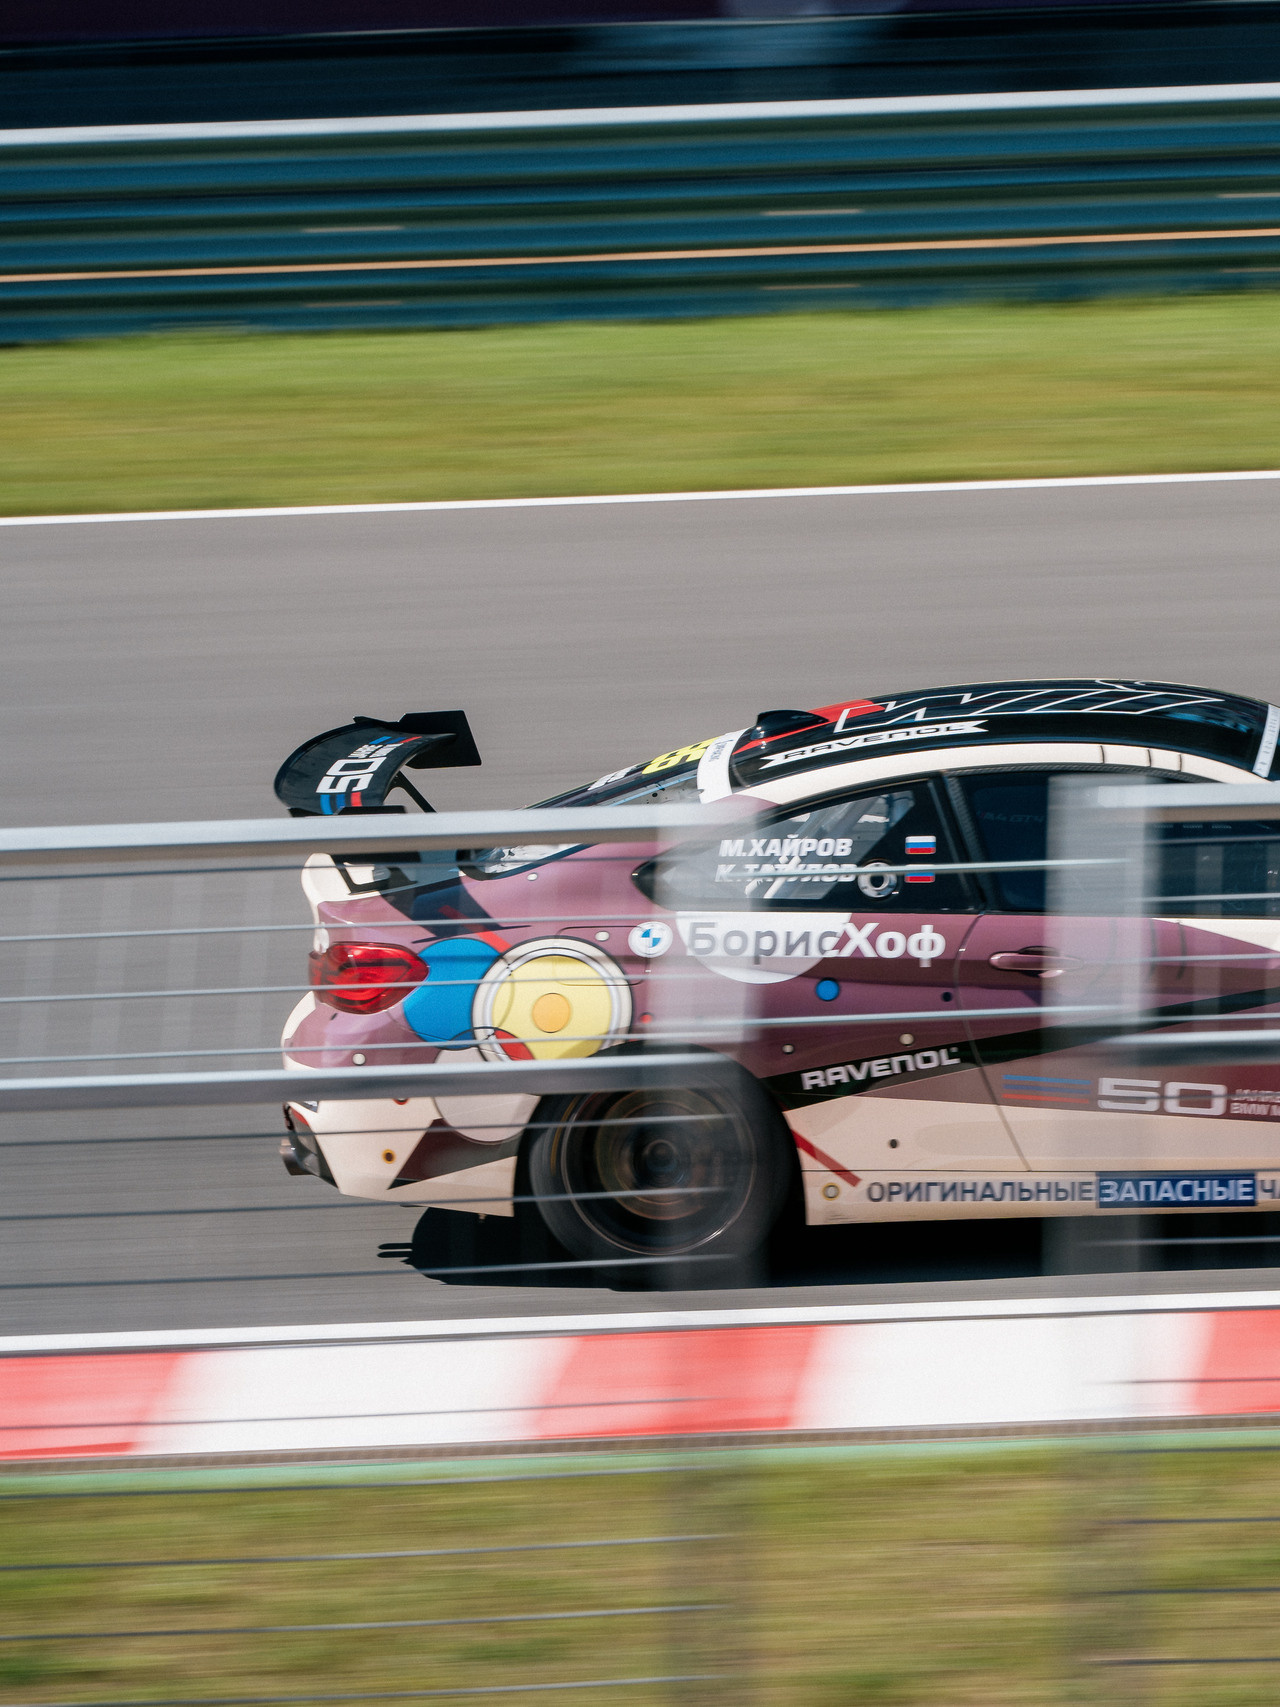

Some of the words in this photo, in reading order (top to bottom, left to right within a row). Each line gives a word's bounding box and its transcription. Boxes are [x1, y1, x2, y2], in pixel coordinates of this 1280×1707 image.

[782, 725, 967, 760] RAVENOL
[315, 756, 387, 794] 50
[719, 834, 853, 857] М.ХАЙРОВ
[688, 921, 947, 968] БорисХоф
[801, 1047, 960, 1090] RAVENOL
[1097, 1077, 1228, 1116] 50
[866, 1181, 1094, 1202] ОРИГИНАЛЬНЫЕ
[1099, 1179, 1254, 1202] ЗАПАСНЫЕ
